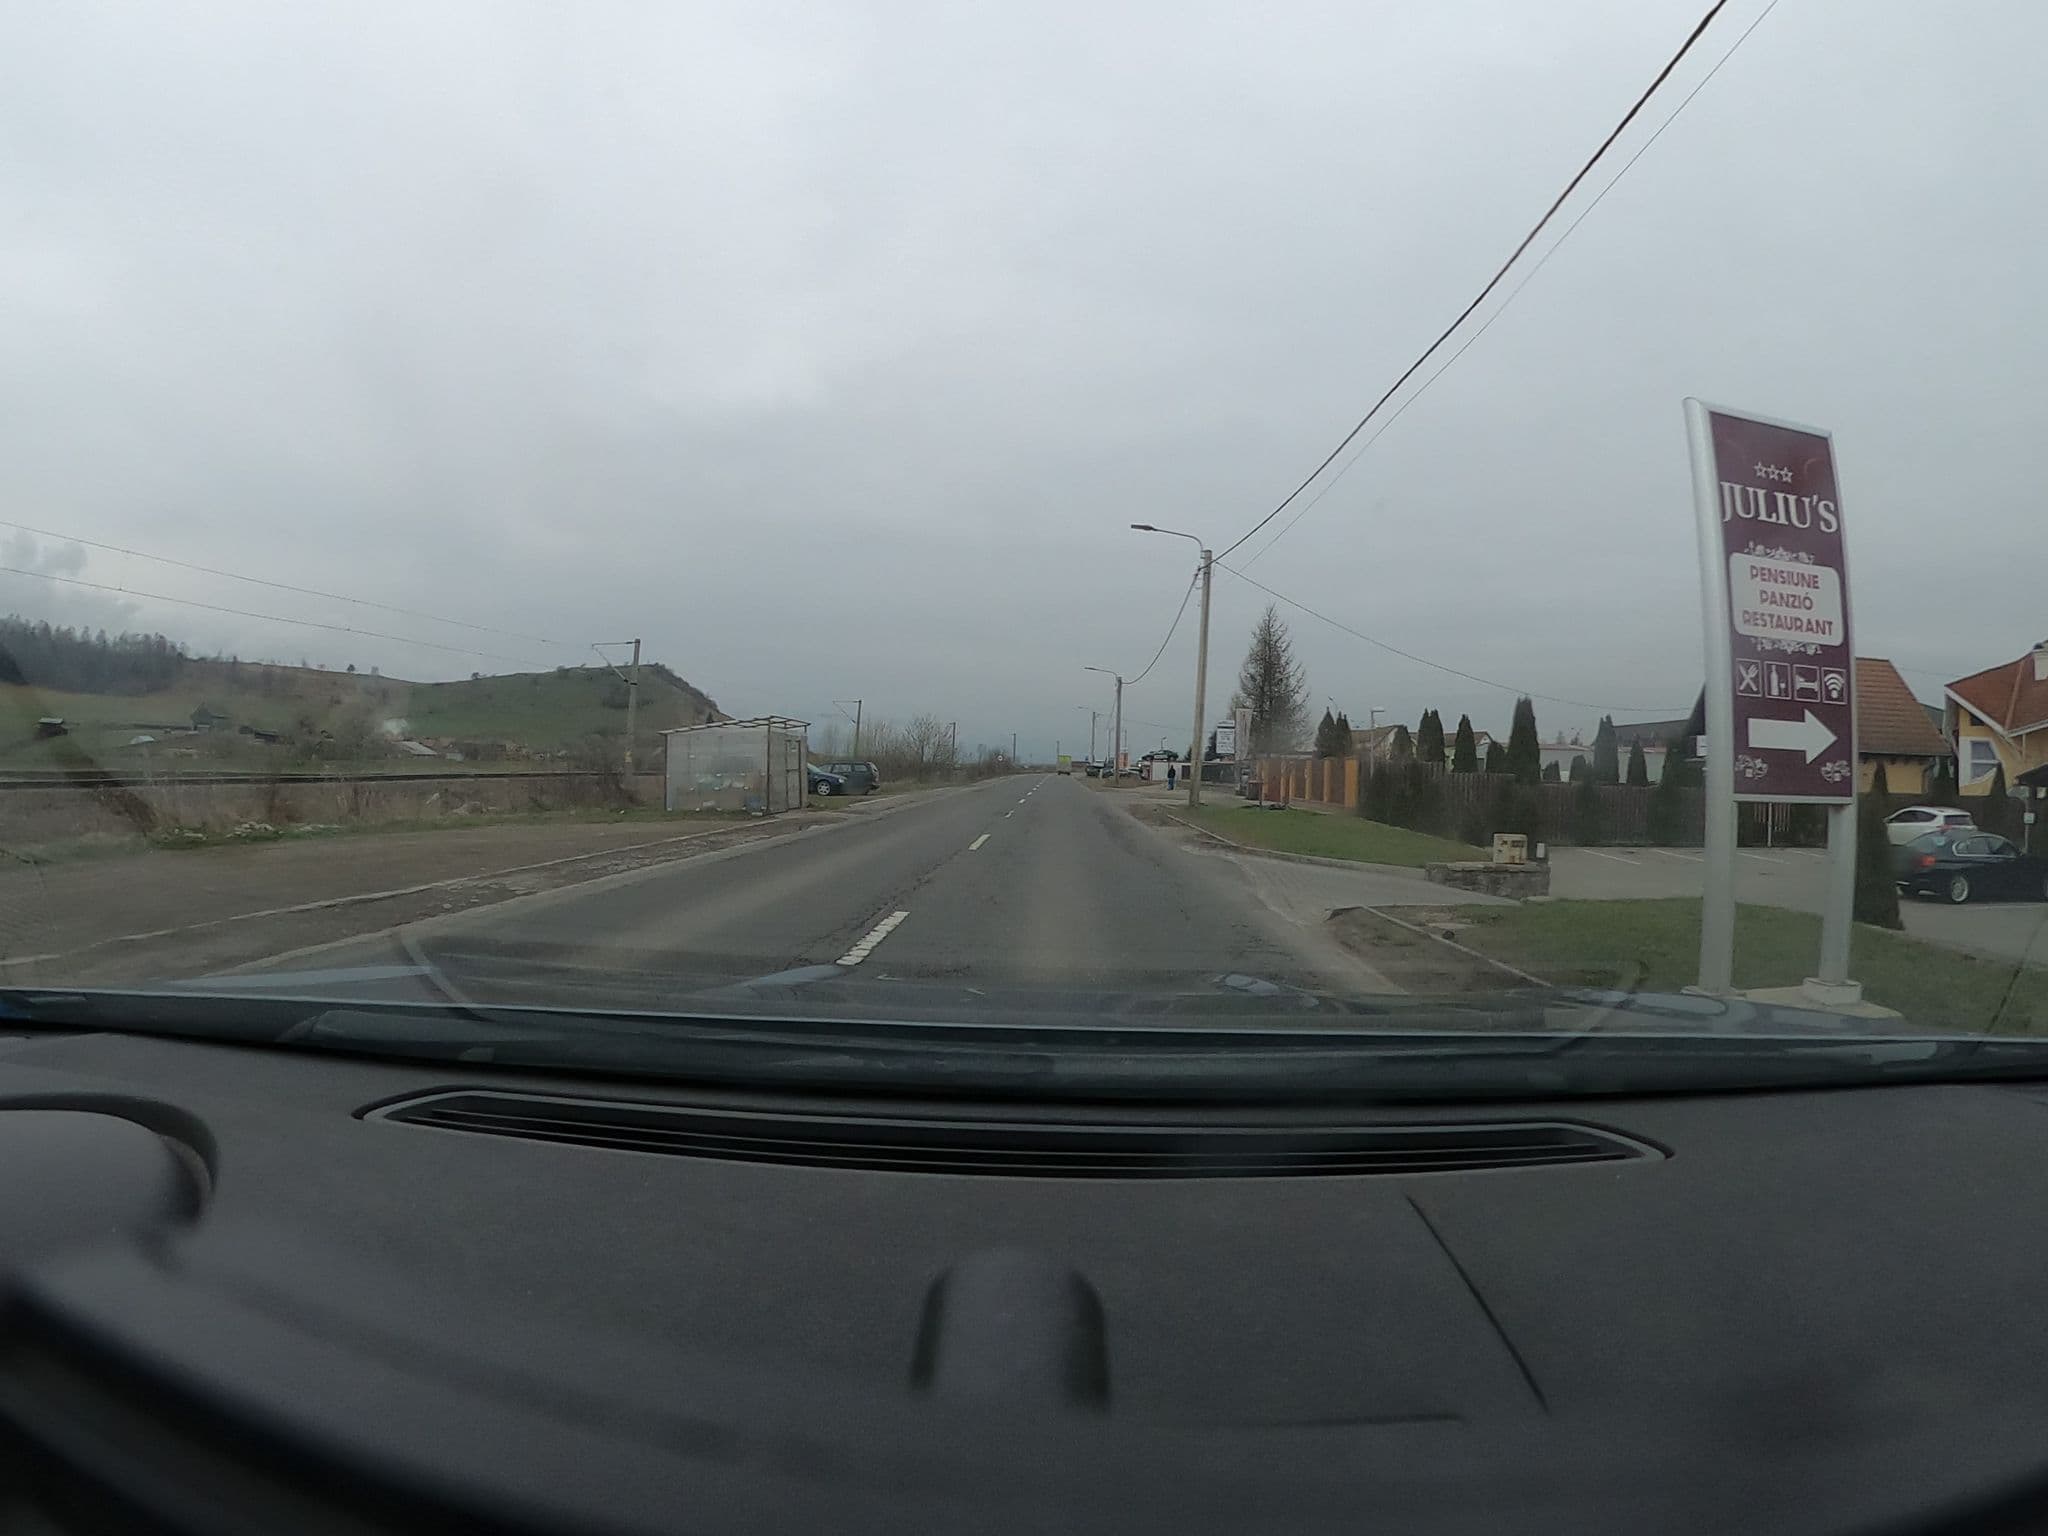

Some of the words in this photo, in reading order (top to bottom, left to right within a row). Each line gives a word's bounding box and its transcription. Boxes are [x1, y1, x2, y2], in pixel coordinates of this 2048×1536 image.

[1720, 481, 1838, 533] JULIU'S
[1750, 564, 1820, 590] PENSIUNE
[1759, 589, 1813, 611] PANZIÓ
[1743, 610, 1833, 636] RESTAURANT
